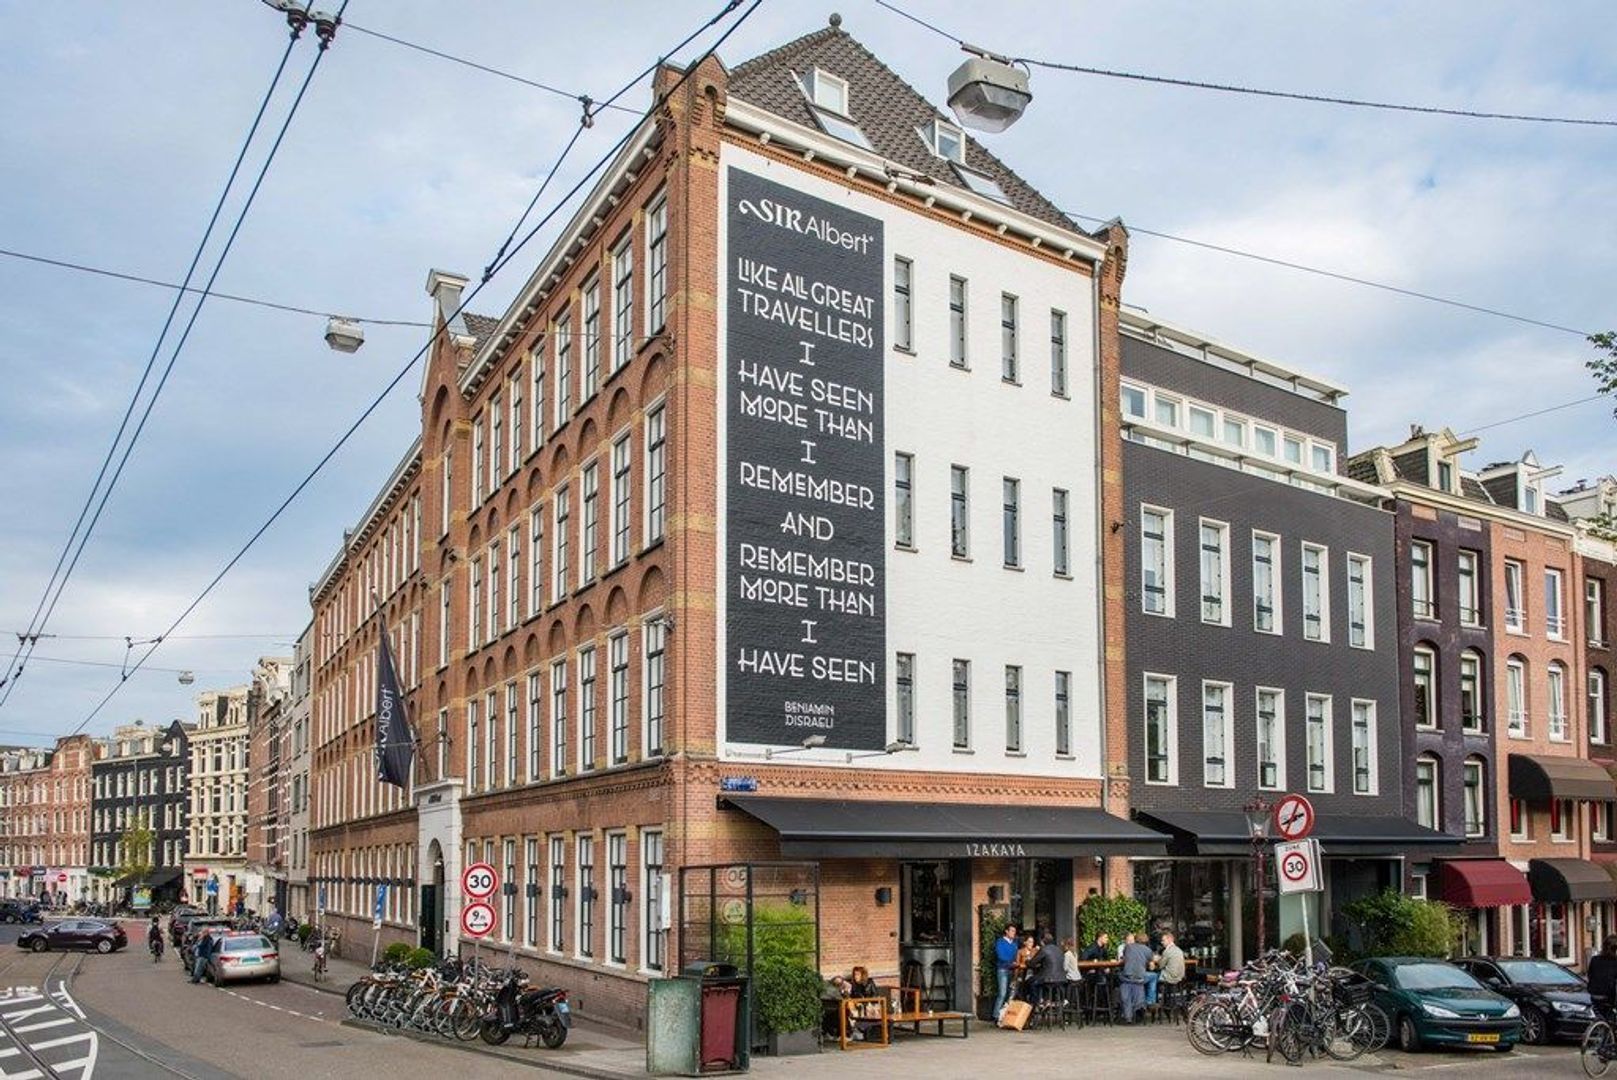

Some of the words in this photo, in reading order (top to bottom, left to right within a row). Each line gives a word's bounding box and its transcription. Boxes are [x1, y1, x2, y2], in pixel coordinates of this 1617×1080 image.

[738, 257, 779, 292] LIKE
[781, 272, 809, 301] ALL
[810, 282, 875, 320] GREAT
[737, 288, 874, 349] TRAVELLERS
[799, 341, 815, 366] I
[738, 359, 804, 398] HAVE
[811, 378, 874, 414] SEEN
[740, 391, 808, 429] MORE
[814, 409, 874, 444] THAN
[801, 440, 817, 464] I
[740, 462, 875, 510] REMEMBER
[780, 512, 834, 541] AND
[740, 543, 875, 587] REMEMBER
[740, 575, 808, 608] MORE
[814, 586, 875, 617] THAN
[801, 620, 817, 643] I
[738, 648, 804, 677] HAVE
[812, 656, 875, 684] SEEN
[785, 701, 835, 715] BENJAMIN
[785, 714, 833, 728] DISRAELI
[966, 843, 1026, 857] IZAKAYA
[469, 874, 491, 888] 30
[1287, 860, 1304, 873] 30
